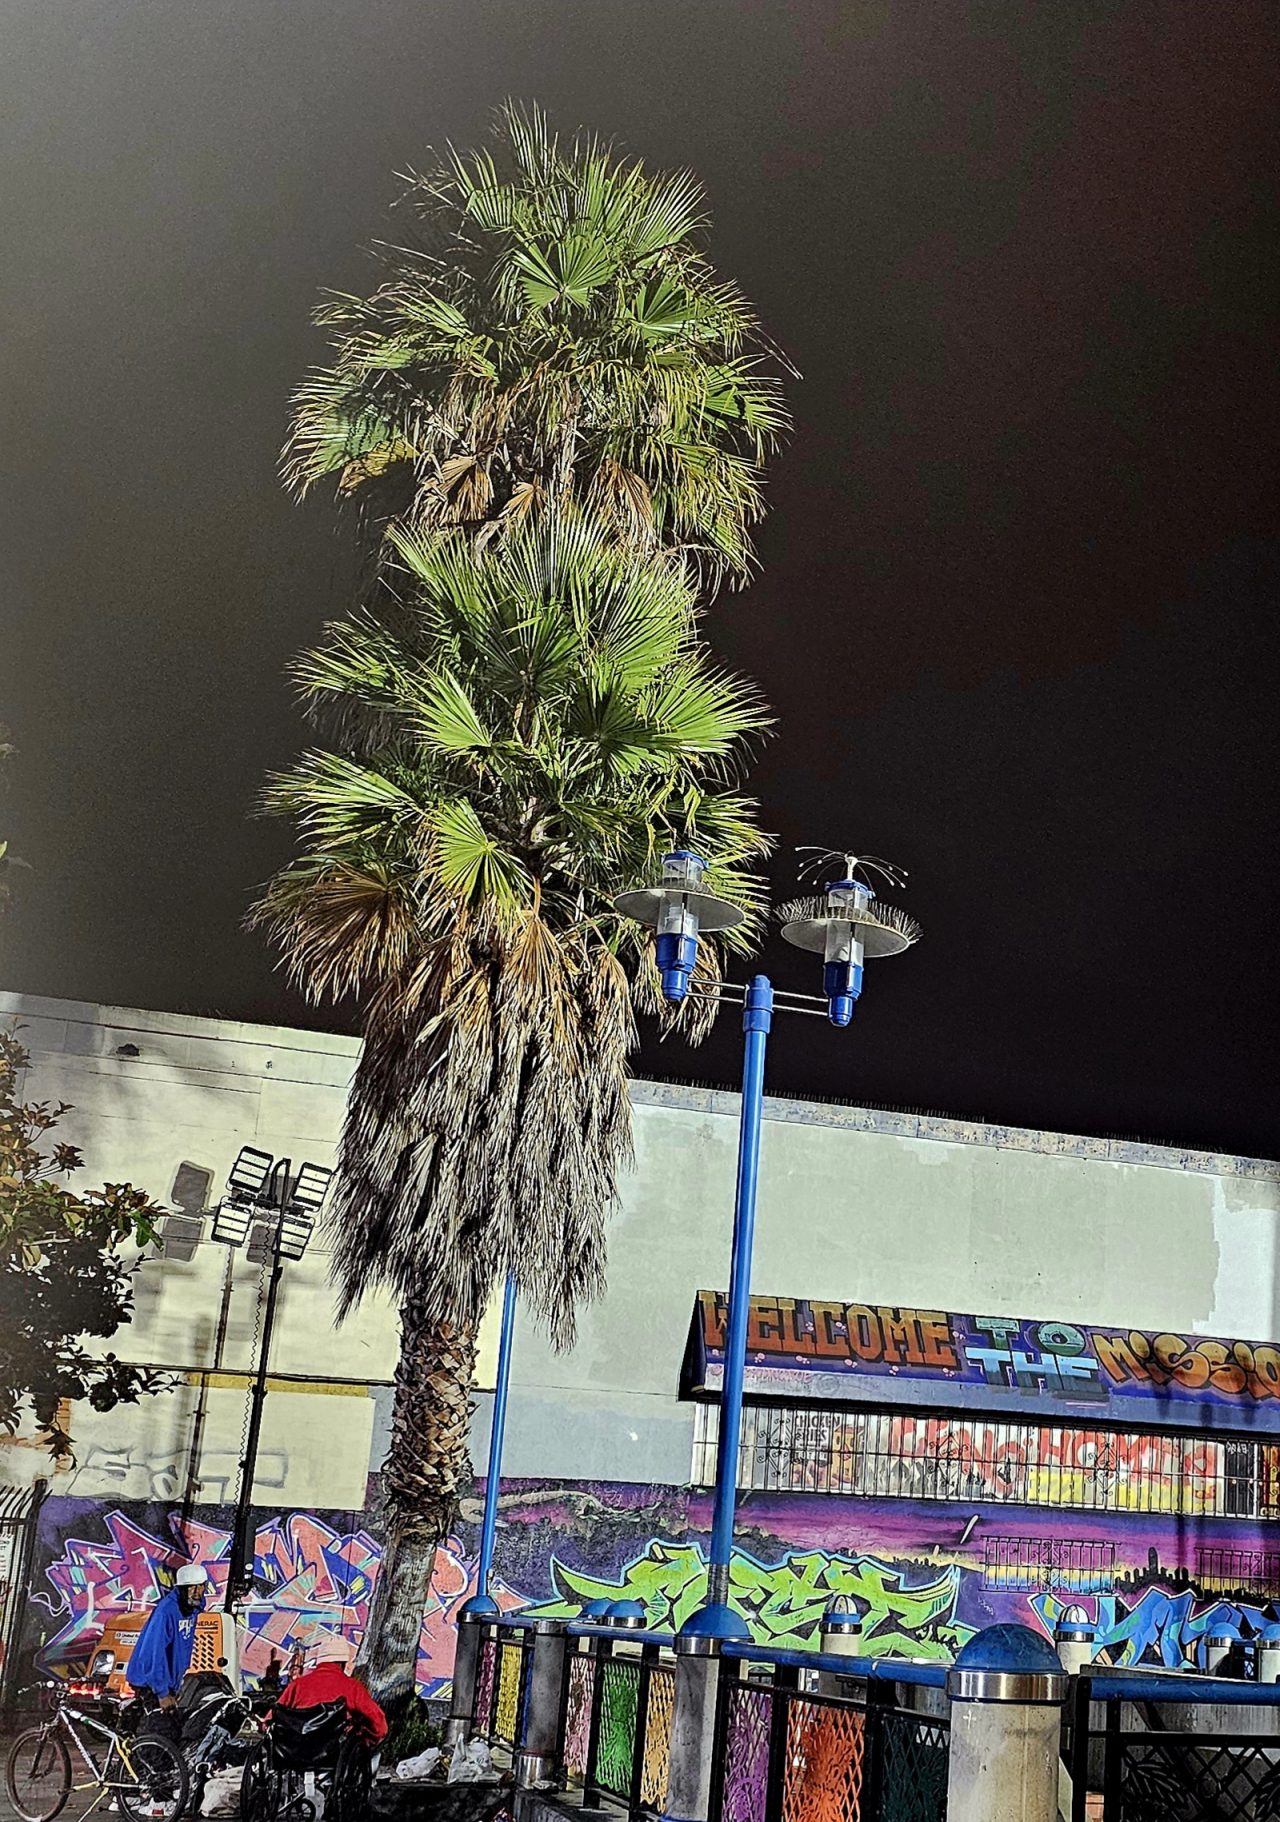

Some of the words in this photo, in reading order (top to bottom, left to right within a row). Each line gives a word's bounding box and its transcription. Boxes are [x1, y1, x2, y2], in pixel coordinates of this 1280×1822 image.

[699, 1289, 957, 1367] WELCOME
[975, 1316, 1088, 1356] TO
[964, 1346, 1101, 1400] THE
